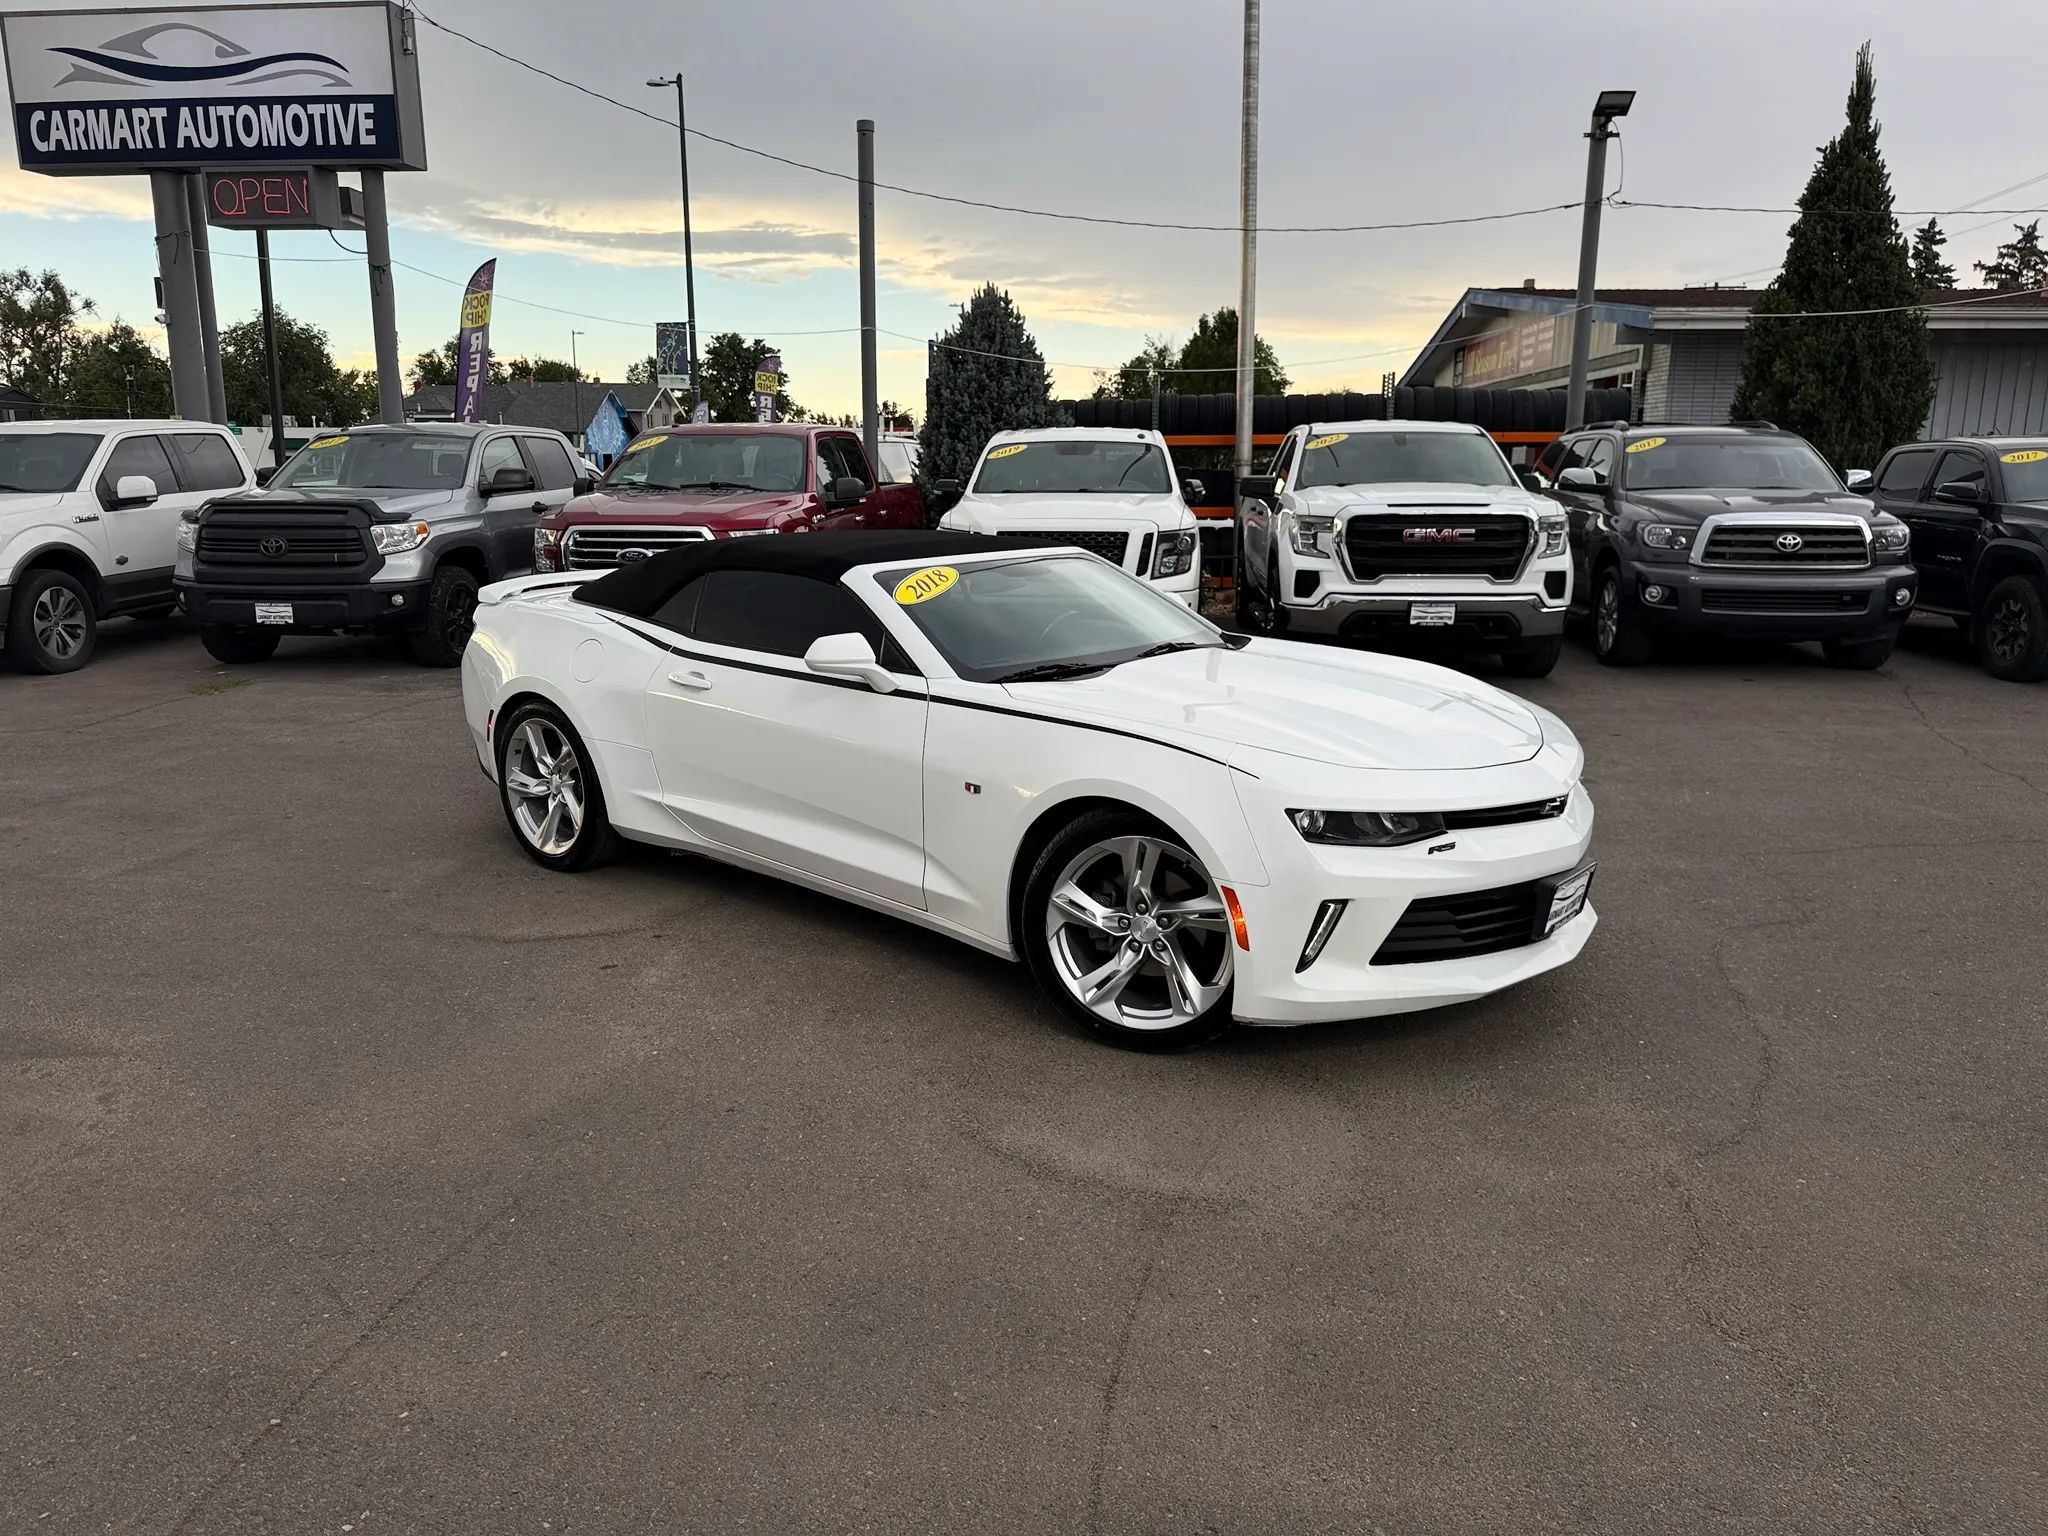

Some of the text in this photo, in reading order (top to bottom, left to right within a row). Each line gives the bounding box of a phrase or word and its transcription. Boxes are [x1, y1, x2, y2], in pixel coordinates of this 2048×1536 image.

[30, 103, 376, 152] CARMART AUTOMOTIVE
[213, 178, 310, 216] OPEN
[1315, 435, 1341, 447] 2022
[1635, 438, 1657, 451] 2017
[995, 445, 1020, 457] 2019
[2011, 452, 2038, 462] 2017
[1403, 528, 1475, 544] GMC
[906, 569, 949, 599] 2018
[1427, 841, 1456, 855] RS
